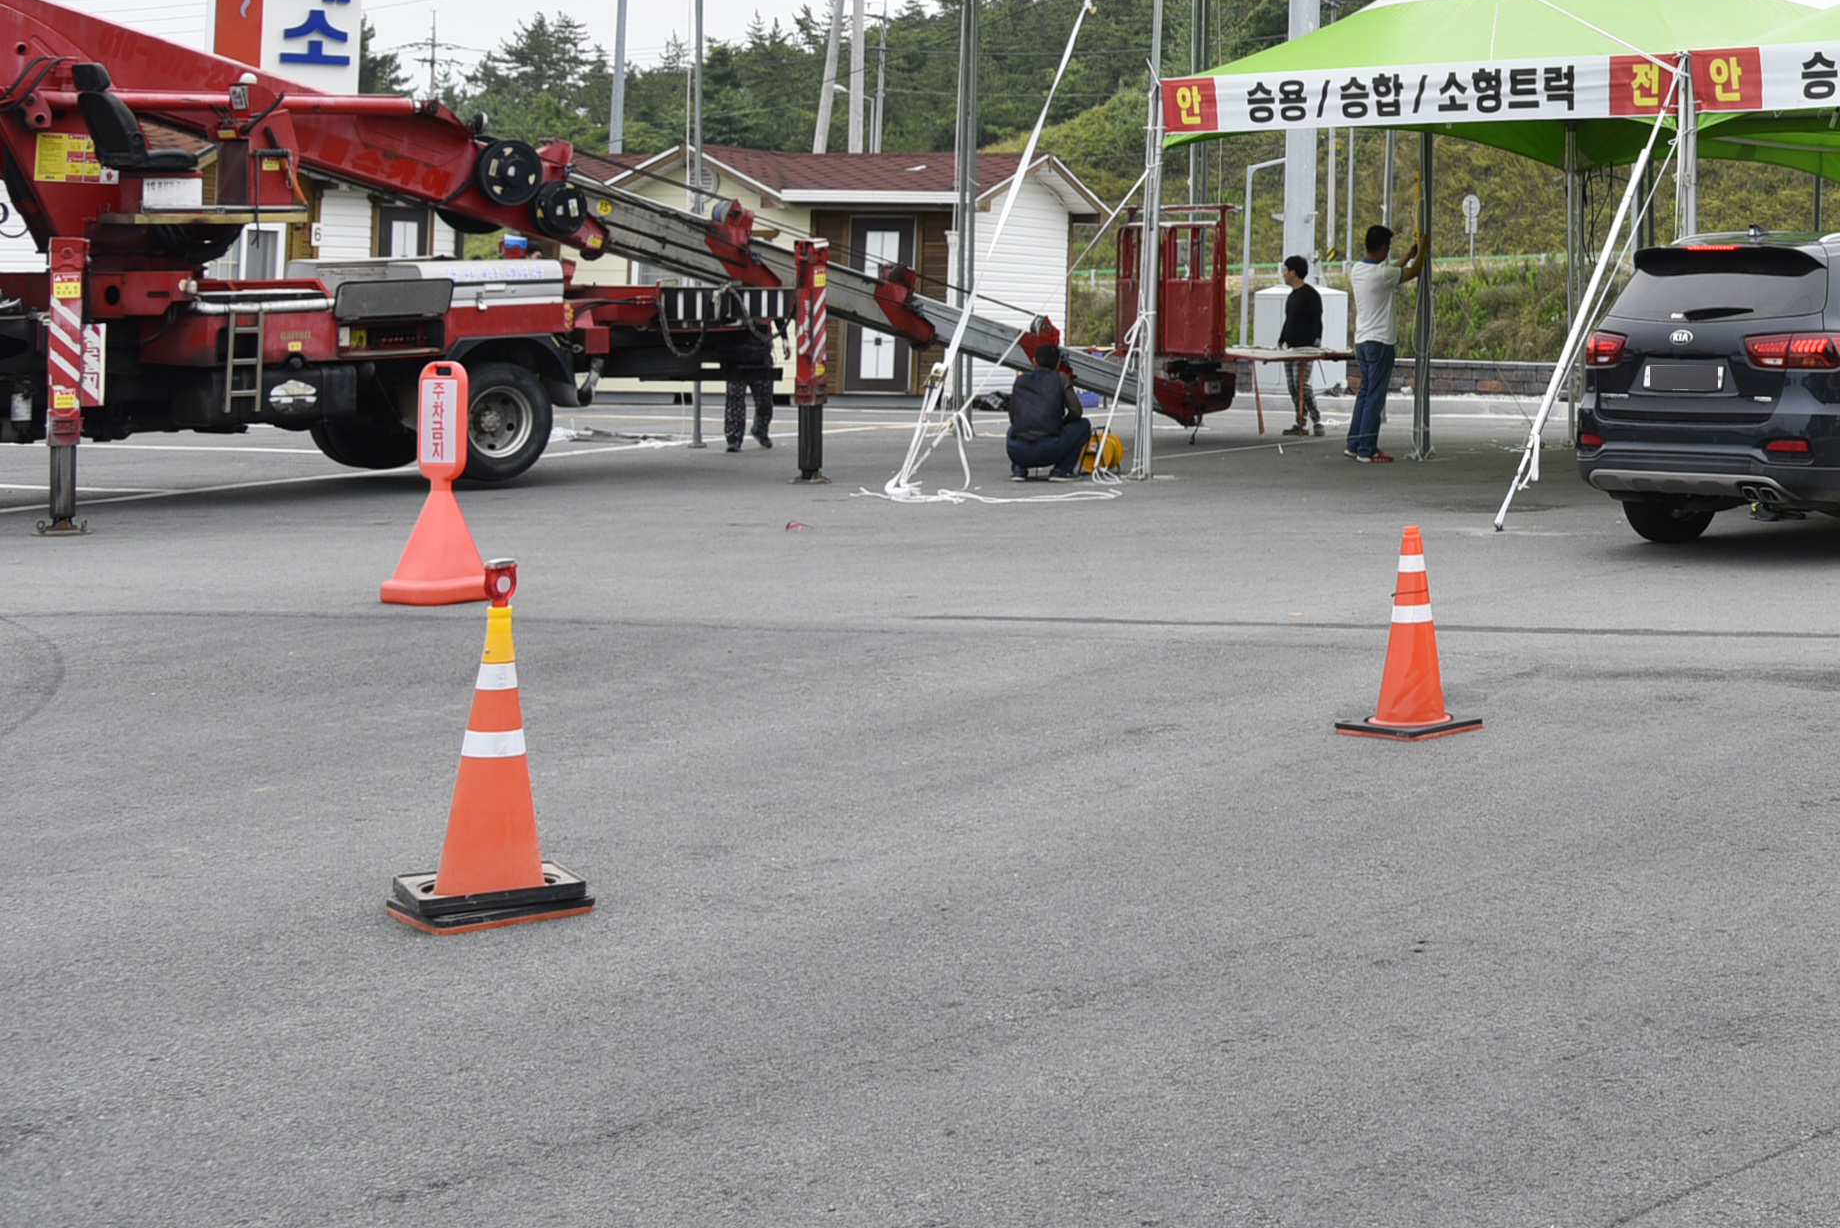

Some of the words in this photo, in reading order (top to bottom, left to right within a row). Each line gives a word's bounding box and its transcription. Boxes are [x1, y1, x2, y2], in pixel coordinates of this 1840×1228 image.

[1176, 86, 1201, 125] 안
[1438, 65, 1574, 113] 소형트럭
[1631, 63, 1659, 107] 전
[1710, 57, 1742, 102] 안
[314, 227, 322, 242] 6
[431, 382, 445, 461] 주차금지
